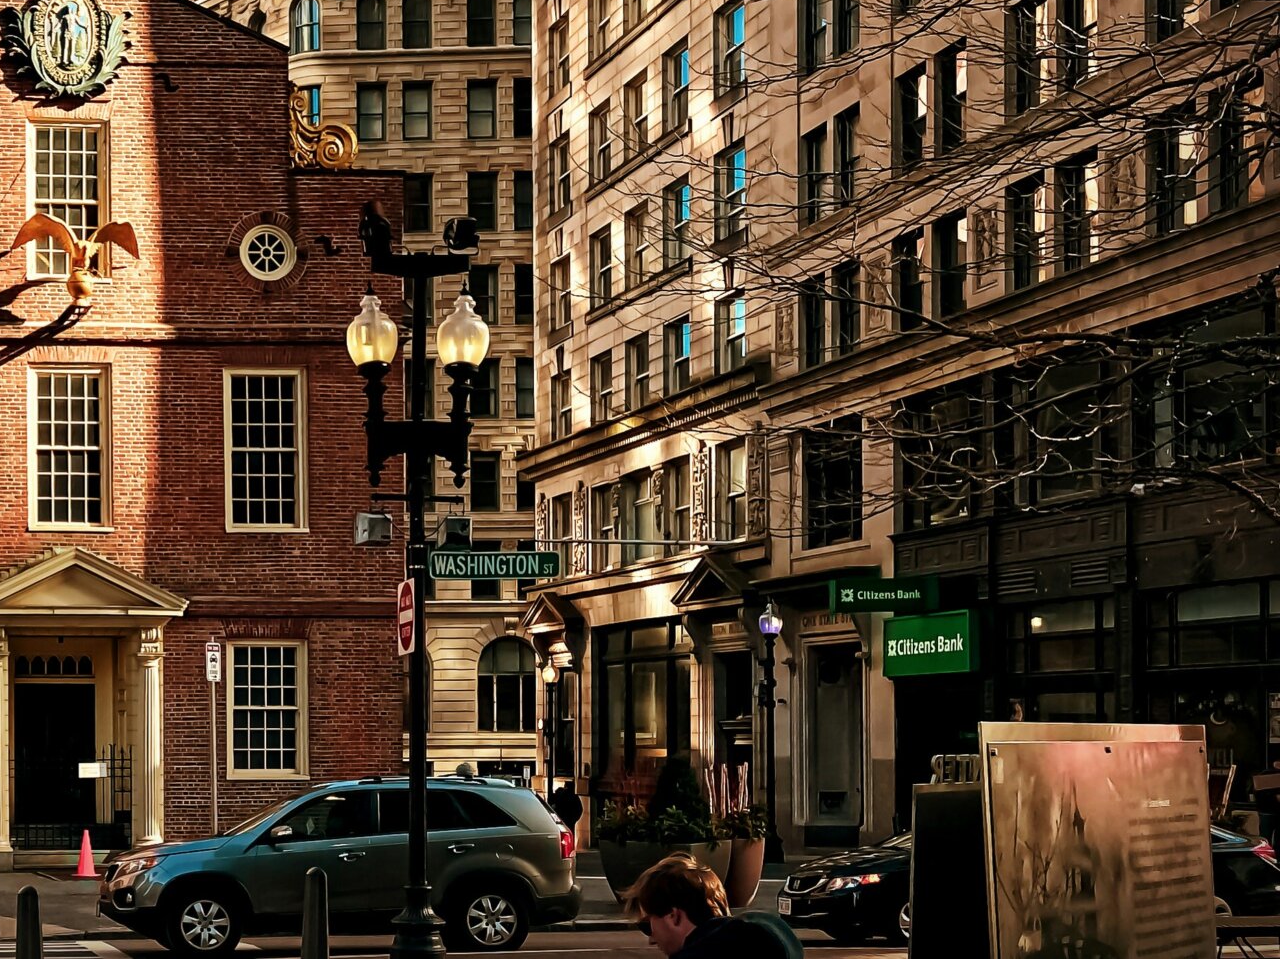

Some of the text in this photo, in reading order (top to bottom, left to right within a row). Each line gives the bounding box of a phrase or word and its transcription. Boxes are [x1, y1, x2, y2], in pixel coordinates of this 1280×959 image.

[434, 555, 554, 575] WASHINGTON ST
[857, 589, 920, 600] Citizens Bank
[897, 633, 963, 655] Citizens Bank
